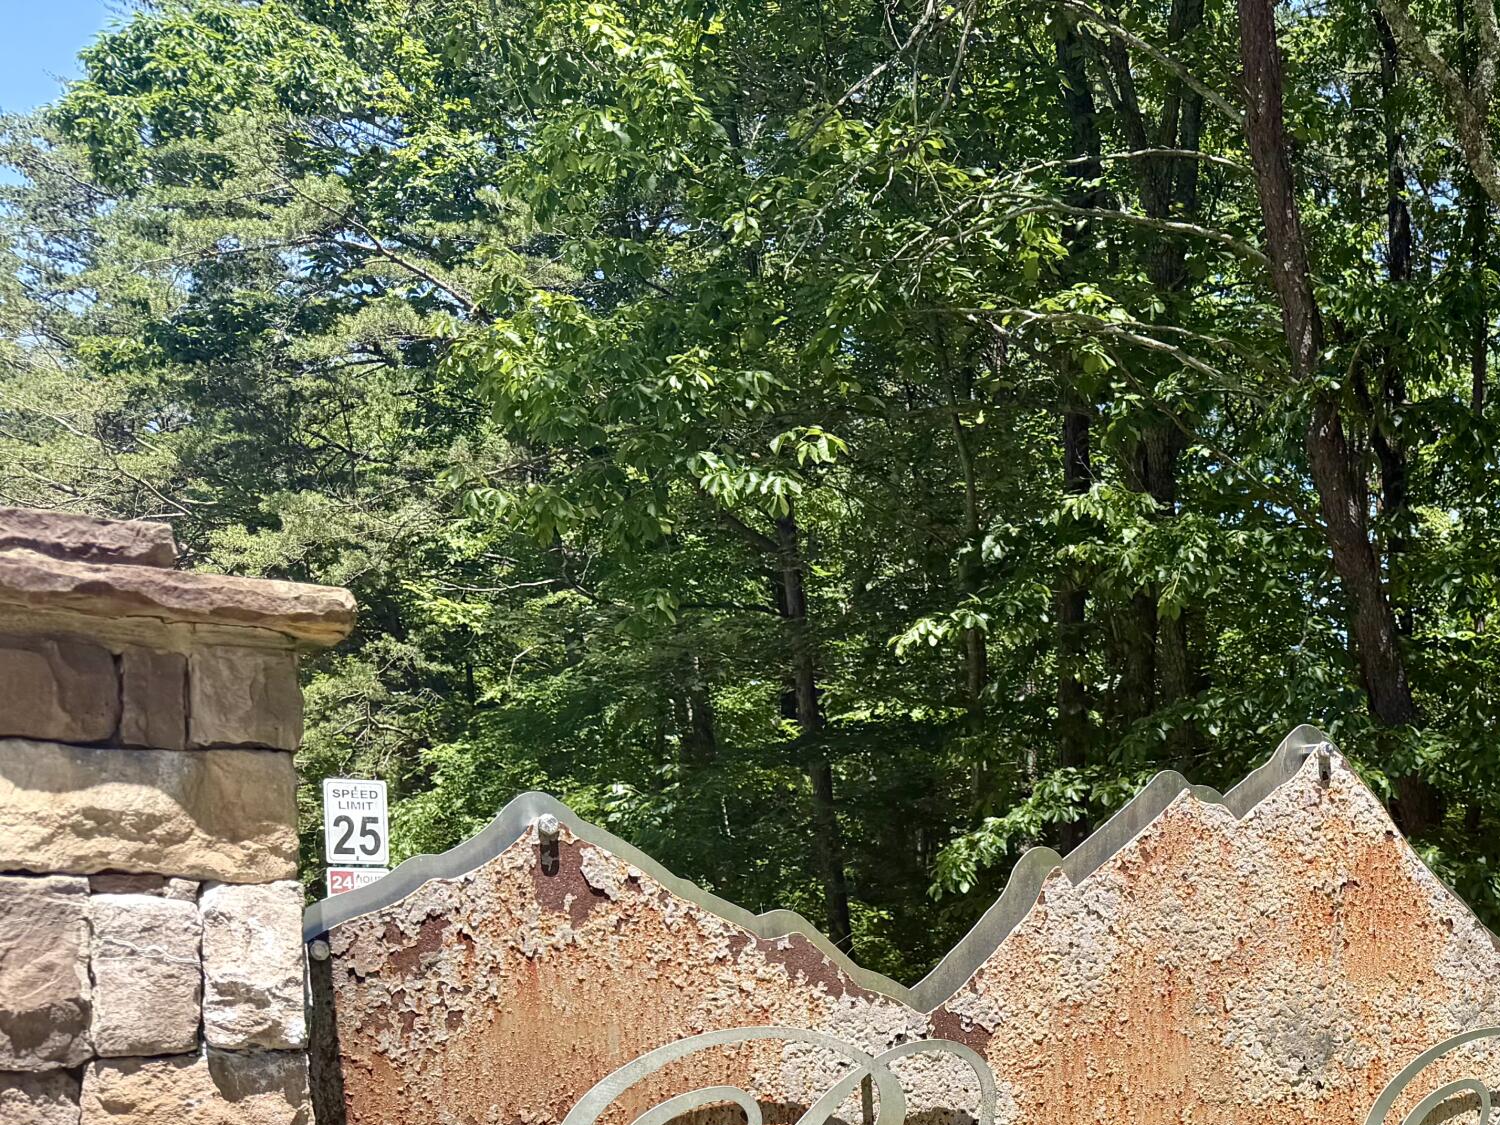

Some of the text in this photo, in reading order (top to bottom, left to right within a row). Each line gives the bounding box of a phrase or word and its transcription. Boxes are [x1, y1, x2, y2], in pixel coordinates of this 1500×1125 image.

[332, 788, 378, 800] SPEED
[338, 800, 374, 811] LIMIT
[332, 814, 381, 856] 25
[332, 875, 354, 890] 24
